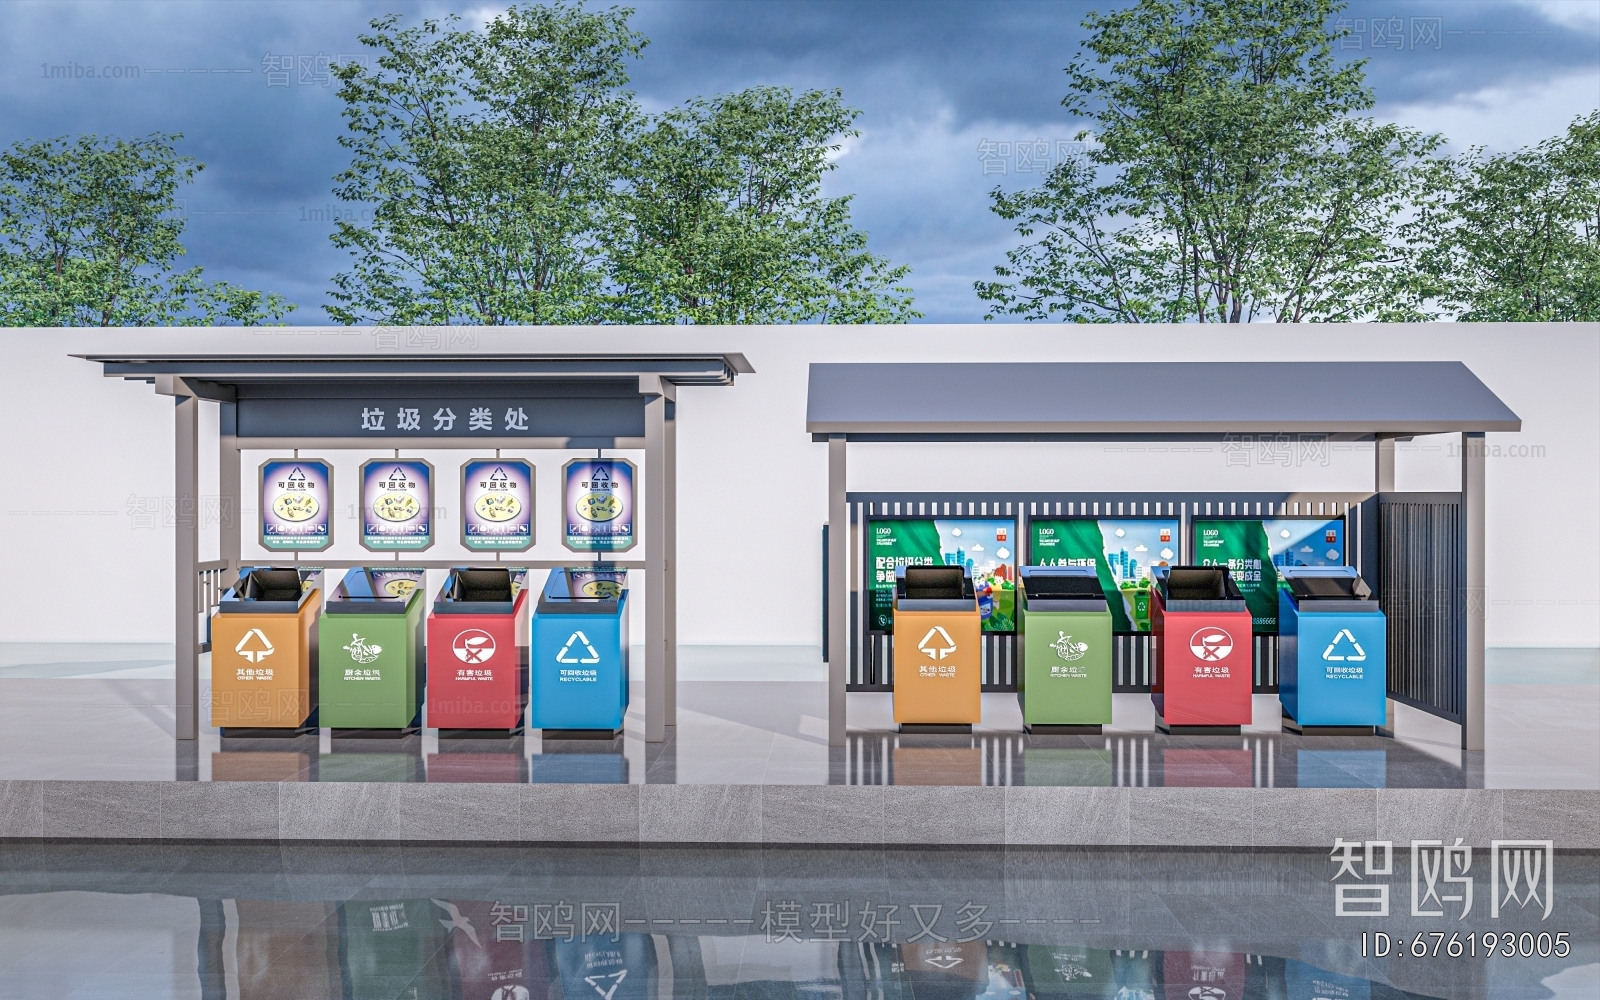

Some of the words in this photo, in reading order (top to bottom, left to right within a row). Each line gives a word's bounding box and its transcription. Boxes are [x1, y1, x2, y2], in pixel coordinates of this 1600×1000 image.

[361, 406, 530, 431] 垃圾分类处
[278, 481, 315, 489] 可回收物
[379, 481, 416, 489] 可回收物
[480, 481, 517, 489] 可回收物
[581, 481, 619, 489] 可回收物
[236, 668, 274, 676] 其他垃圾
[456, 669, 492, 677] 有害垃圾
[560, 669, 597, 677] 可回收垃圾
[919, 665, 956, 673] 其他垃圾
[1194, 666, 1229, 674] 有害垃圾
[1326, 666, 1363, 674] 可回收垃圾
